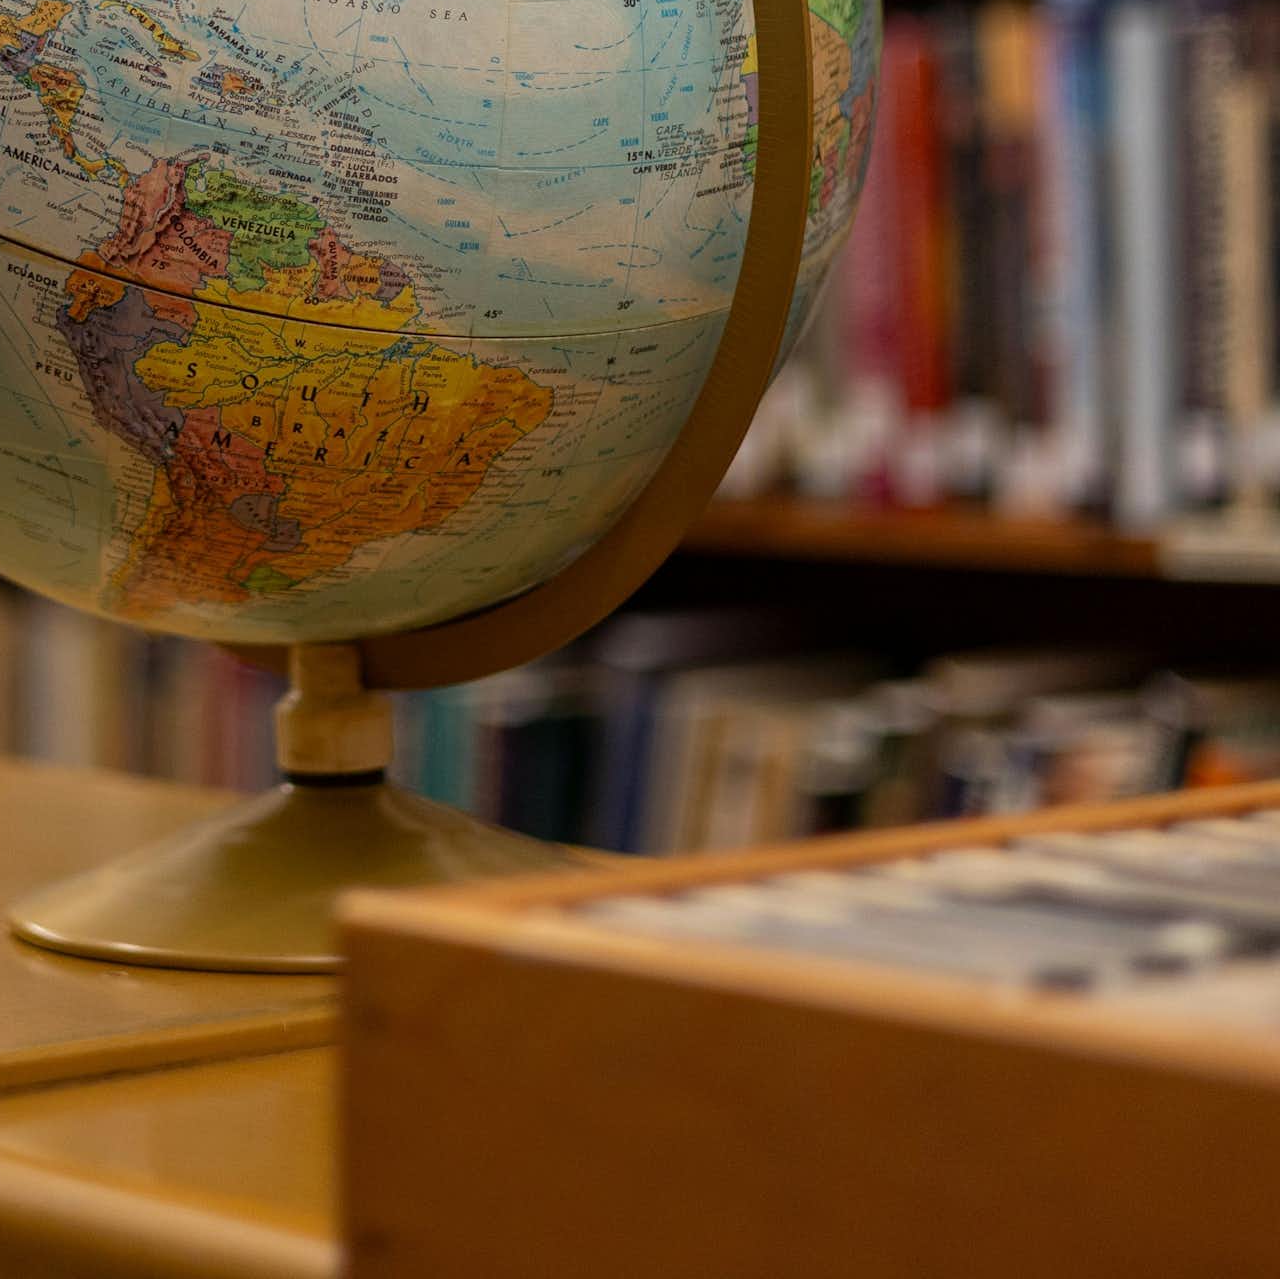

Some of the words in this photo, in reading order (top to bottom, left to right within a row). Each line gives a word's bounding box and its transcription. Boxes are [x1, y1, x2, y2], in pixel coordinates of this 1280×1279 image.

[429, 8, 468, 22] SEA
[128, 6, 167, 42] CUBA
[206, 19, 252, 56] BAHAMAS
[47, 39, 79, 56] BELIZE
[120, 26, 163, 68] GREATER
[110, 55, 150, 72] JAMAICA
[139, 74, 173, 90] Kingston
[96, 65, 228, 130] CARIBBEAN
[187, 90, 244, 116] ANTILLES
[656, 123, 685, 136] CAPE
[329, 143, 377, 158] DOMINICA
[626, 150, 644, 163] 15°
[657, 144, 693, 158] VERDE
[2, 145, 61, 175] AMERICA
[346, 162, 376, 174] LUCIA
[268, 168, 312, 184] GRENADA
[344, 170, 400, 185] BARBADOS
[659, 166, 705, 181] ISLANDS
[347, 195, 392, 207] TRINIDAD
[350, 211, 389, 224] TOBAGO
[362, 205, 383, 215] AND
[221, 215, 297, 241] VENEZUELA
[7, 263, 59, 289] ECUADOR
[342, 273, 380, 285] SURINAME
[35, 361, 73, 382] PERU
